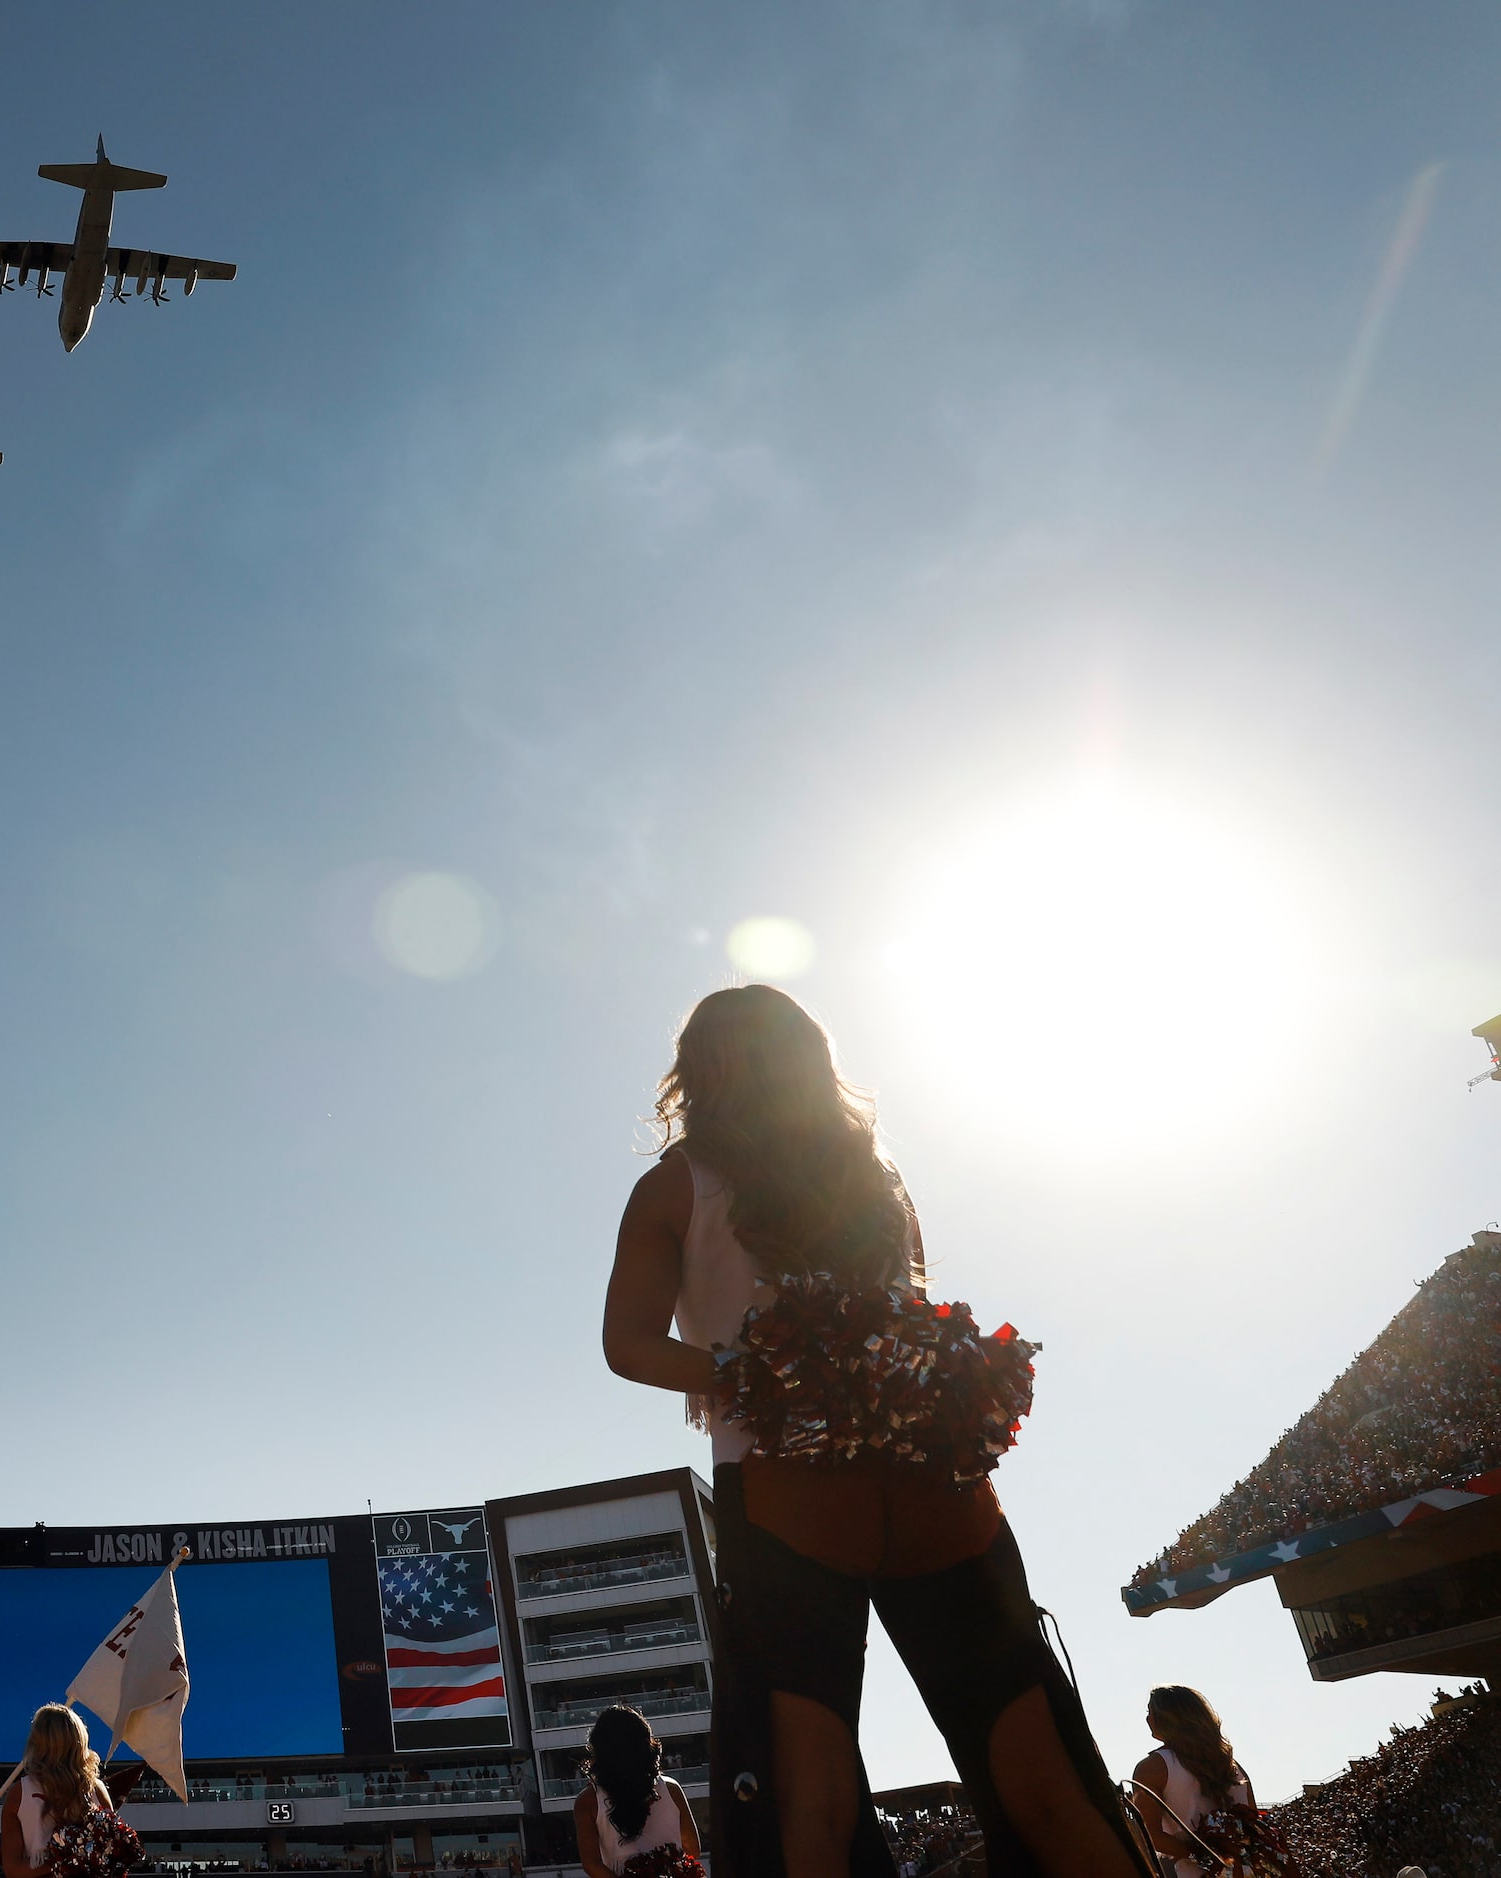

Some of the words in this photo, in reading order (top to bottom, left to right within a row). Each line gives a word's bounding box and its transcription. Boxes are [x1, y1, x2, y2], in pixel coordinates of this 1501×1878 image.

[87, 1533, 161, 1563] JASON
[172, 1532, 194, 1561] &
[198, 1529, 268, 1560] KISHA
[273, 1524, 336, 1555] ITKIN
[387, 1546, 421, 1556] PLAYOFF
[271, 1804, 290, 1820] 25
